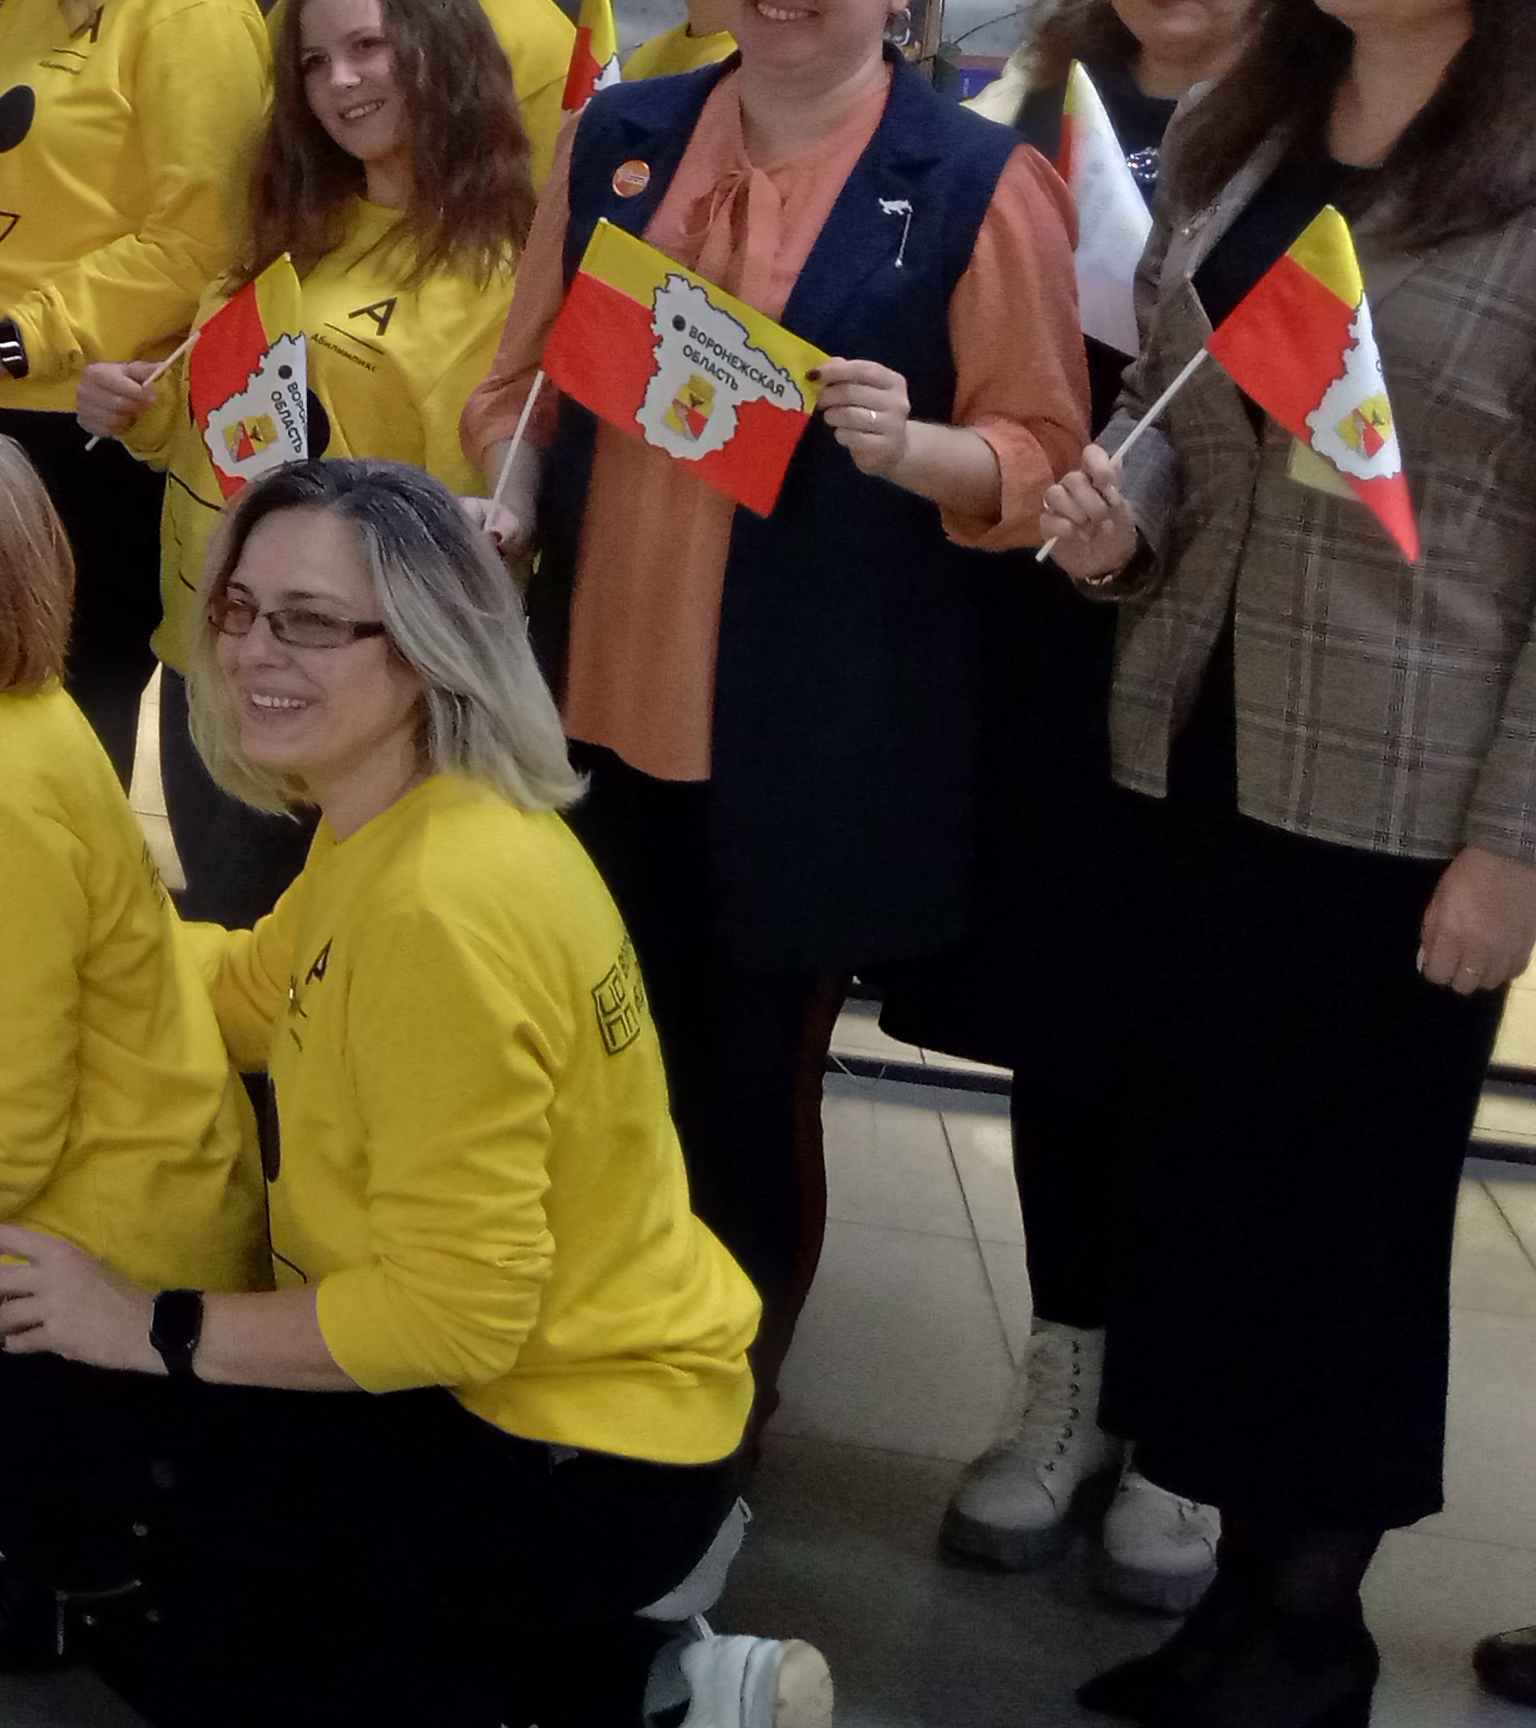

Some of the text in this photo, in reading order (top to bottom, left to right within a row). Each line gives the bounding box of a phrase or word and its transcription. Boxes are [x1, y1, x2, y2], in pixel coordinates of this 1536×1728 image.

[348, 296, 398, 336] А
[310, 332, 377, 373] Абилимпикс
[682, 344, 740, 391] ОБЛАСТЬ
[688, 324, 786, 398] ВОРОНЕЖСКАЯ
[270, 390, 303, 454] ОБЛАСТЬ
